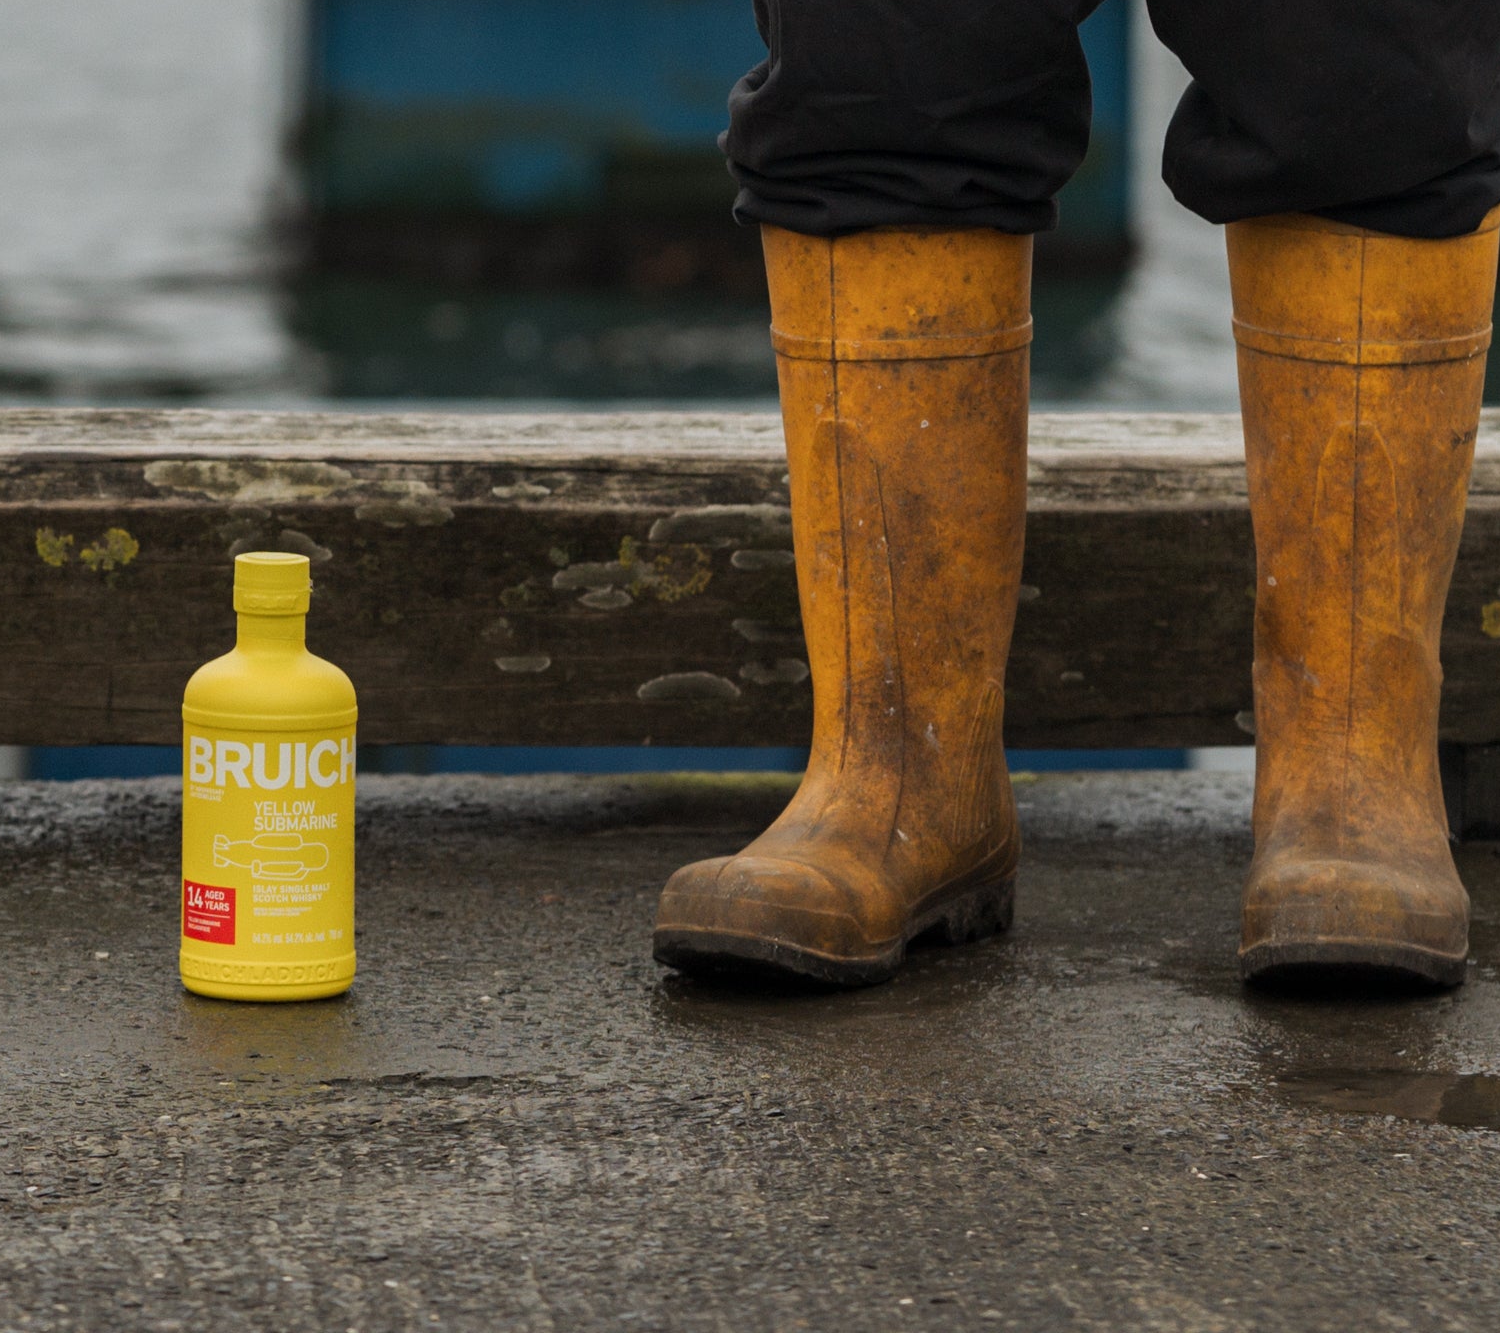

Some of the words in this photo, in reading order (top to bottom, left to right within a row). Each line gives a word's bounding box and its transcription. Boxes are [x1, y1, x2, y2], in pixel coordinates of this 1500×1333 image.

[254, 801, 316, 817] YELLOW
[254, 813, 338, 832] SUBMARINE
[253, 884, 278, 894] ISLAY
[279, 884, 309, 894] SINGLE
[187, 886, 204, 909] 14
[205, 890, 225, 901] AGED
[253, 893, 288, 903] SCOTCH
[290, 892, 322, 902] WHISKY
[205, 900, 230, 912] YEARS
